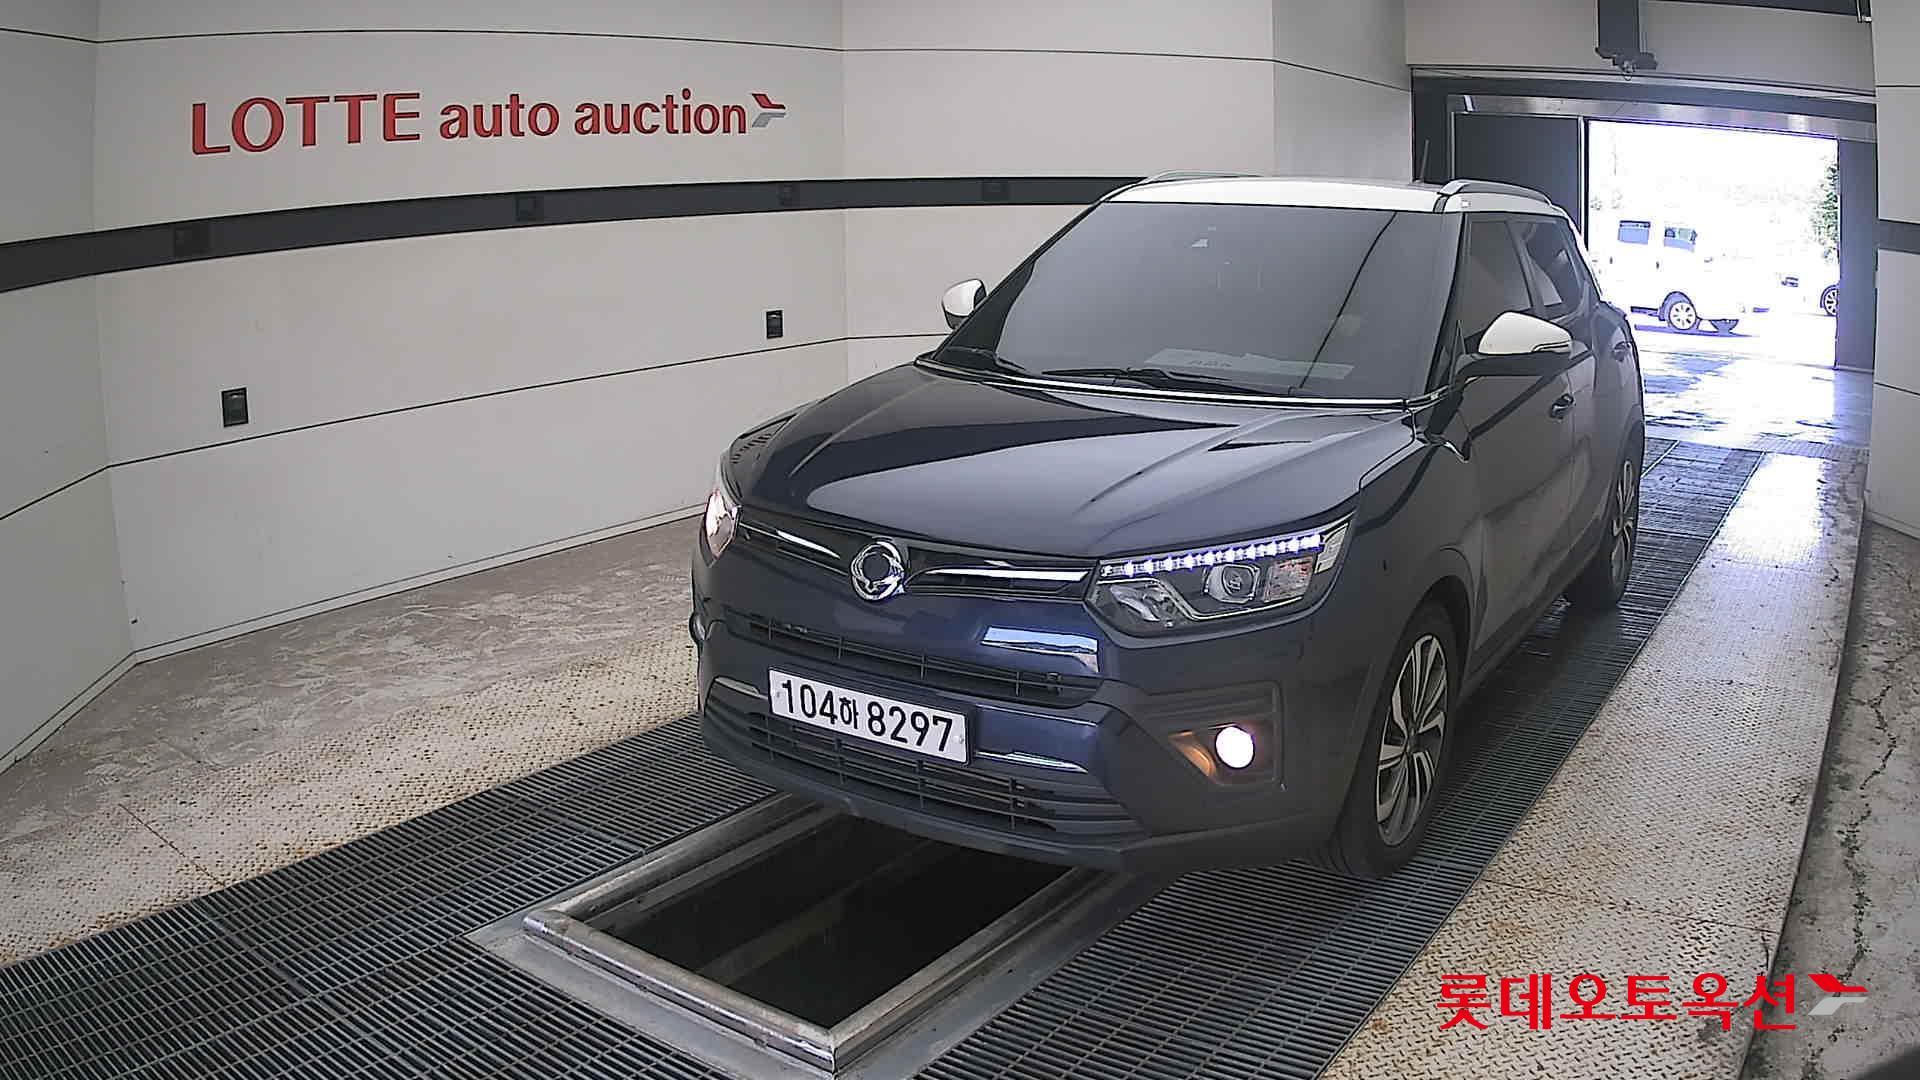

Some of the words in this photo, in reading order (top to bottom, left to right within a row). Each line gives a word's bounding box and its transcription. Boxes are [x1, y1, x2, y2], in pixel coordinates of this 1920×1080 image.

[191, 93, 420, 155] LOTTE
[439, 94, 560, 139] auto
[574, 88, 747, 135] auction
